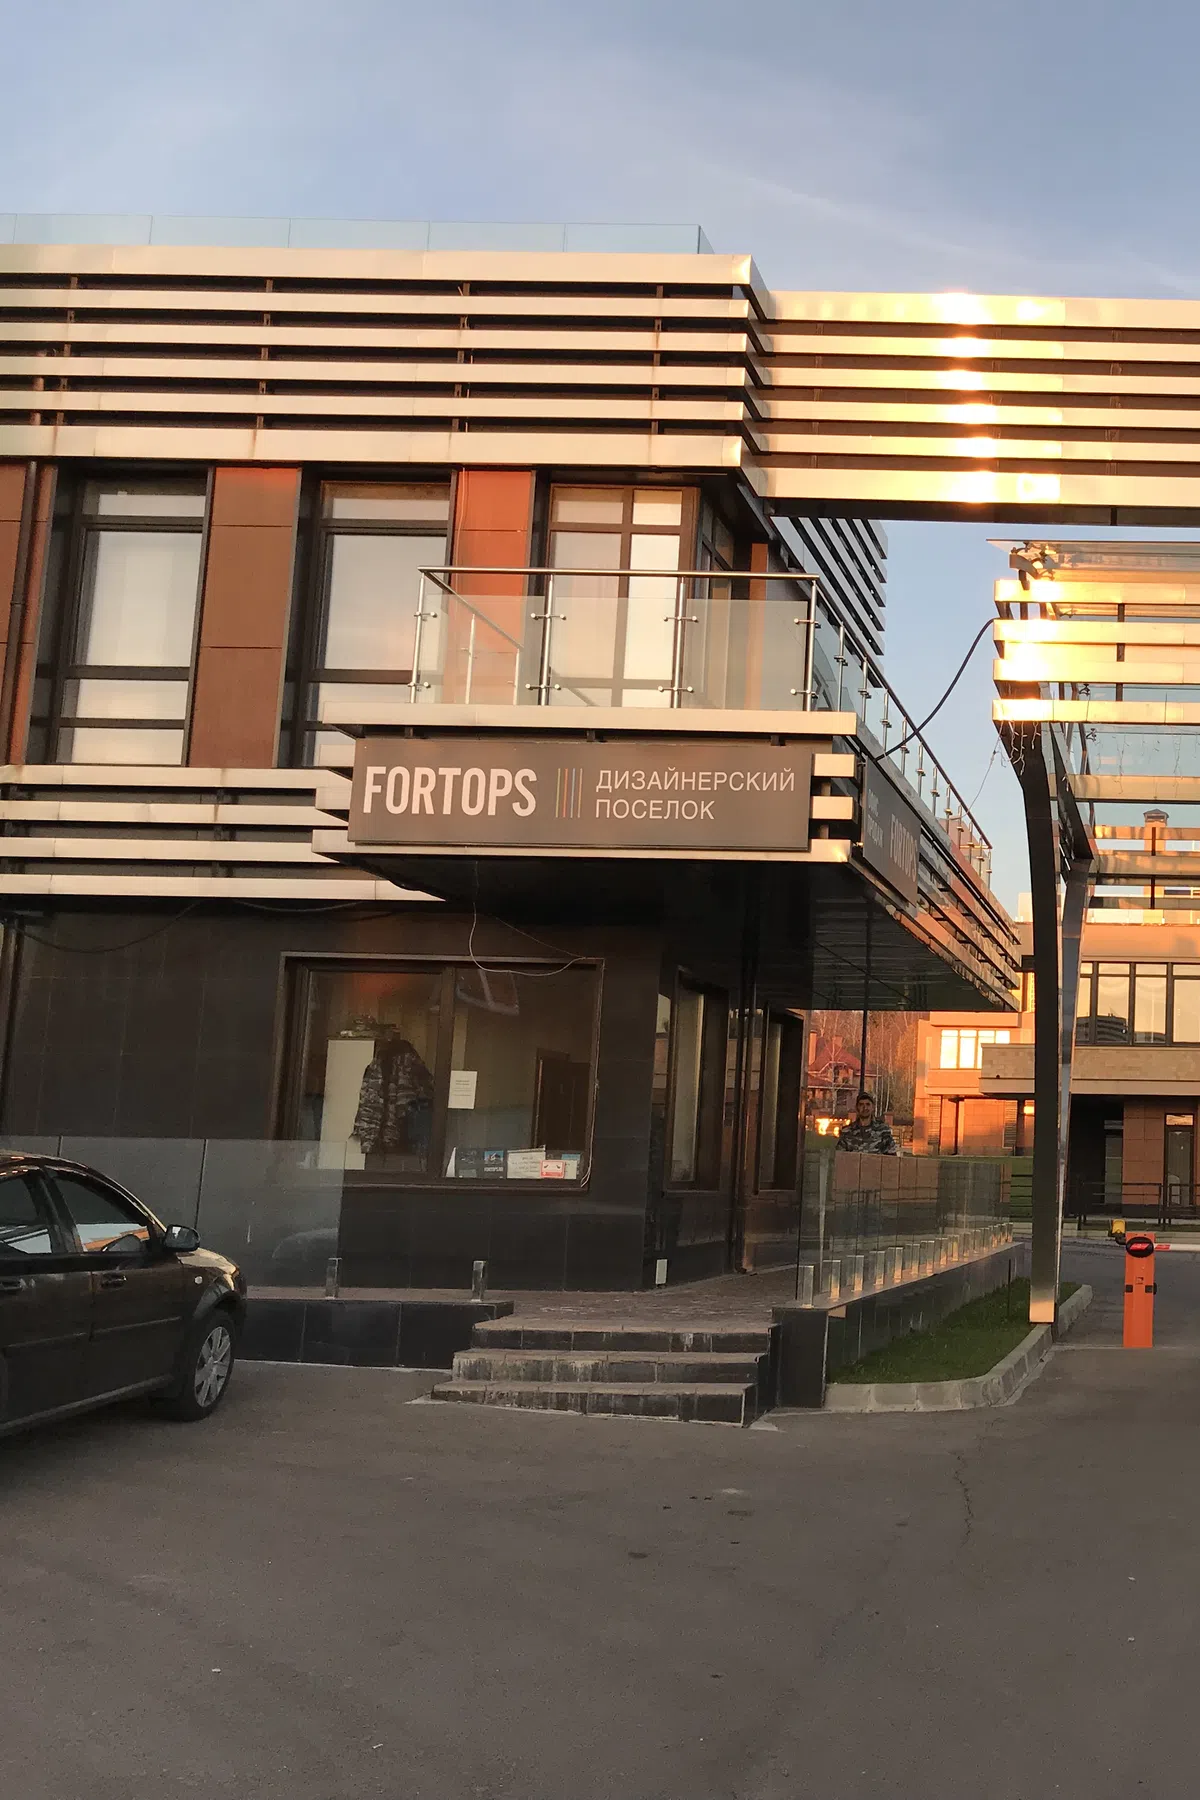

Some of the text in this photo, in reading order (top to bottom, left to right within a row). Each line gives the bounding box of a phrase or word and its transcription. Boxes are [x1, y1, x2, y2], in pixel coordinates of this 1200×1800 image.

[363, 766, 538, 817] FORTOPS
[595, 766, 795, 793] ДИЗАЙНЕРСКИЙ
[595, 798, 715, 820] ПОСЕЛОК
[890, 813, 918, 882] FORTOPS
